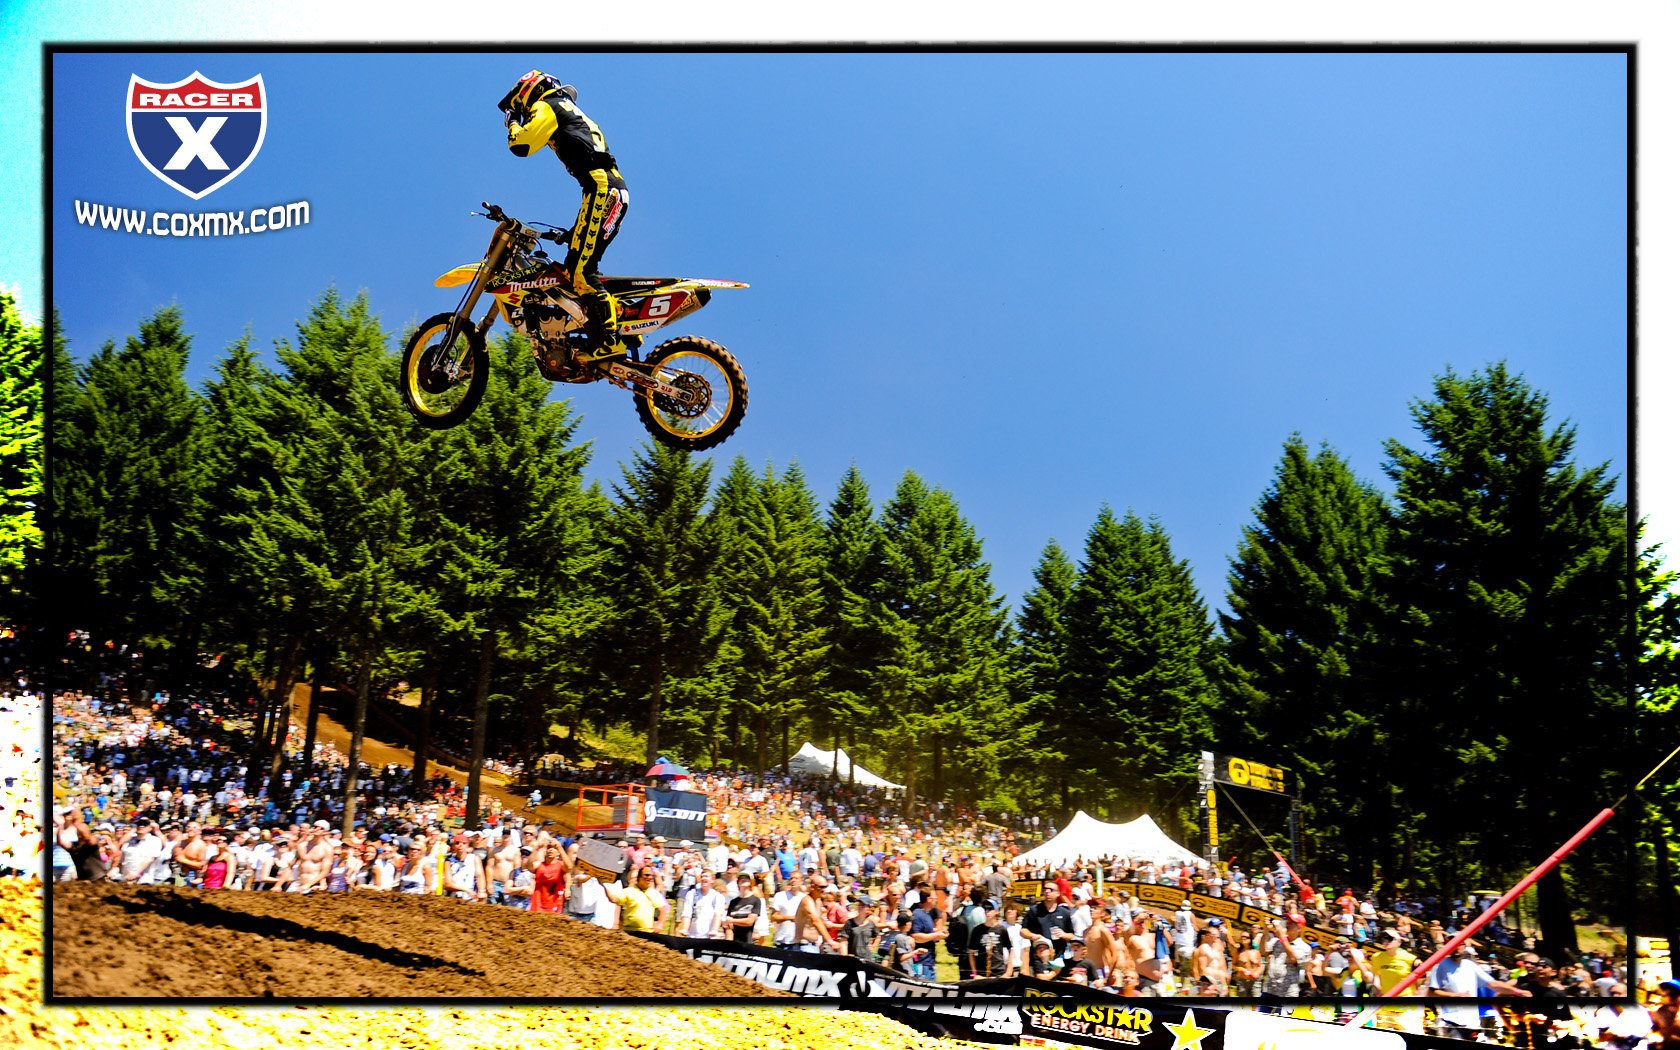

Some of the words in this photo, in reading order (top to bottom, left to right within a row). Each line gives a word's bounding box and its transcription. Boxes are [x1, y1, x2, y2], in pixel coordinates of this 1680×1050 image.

[648, 295, 672, 317] 5
[631, 320, 659, 331] SUZUKI
[656, 807, 707, 822] SCOTT
[1023, 988, 1153, 1032] ROCKSTAR
[1030, 1013, 1090, 1034] ENERGY
[1095, 1023, 1141, 1045] DRINK
